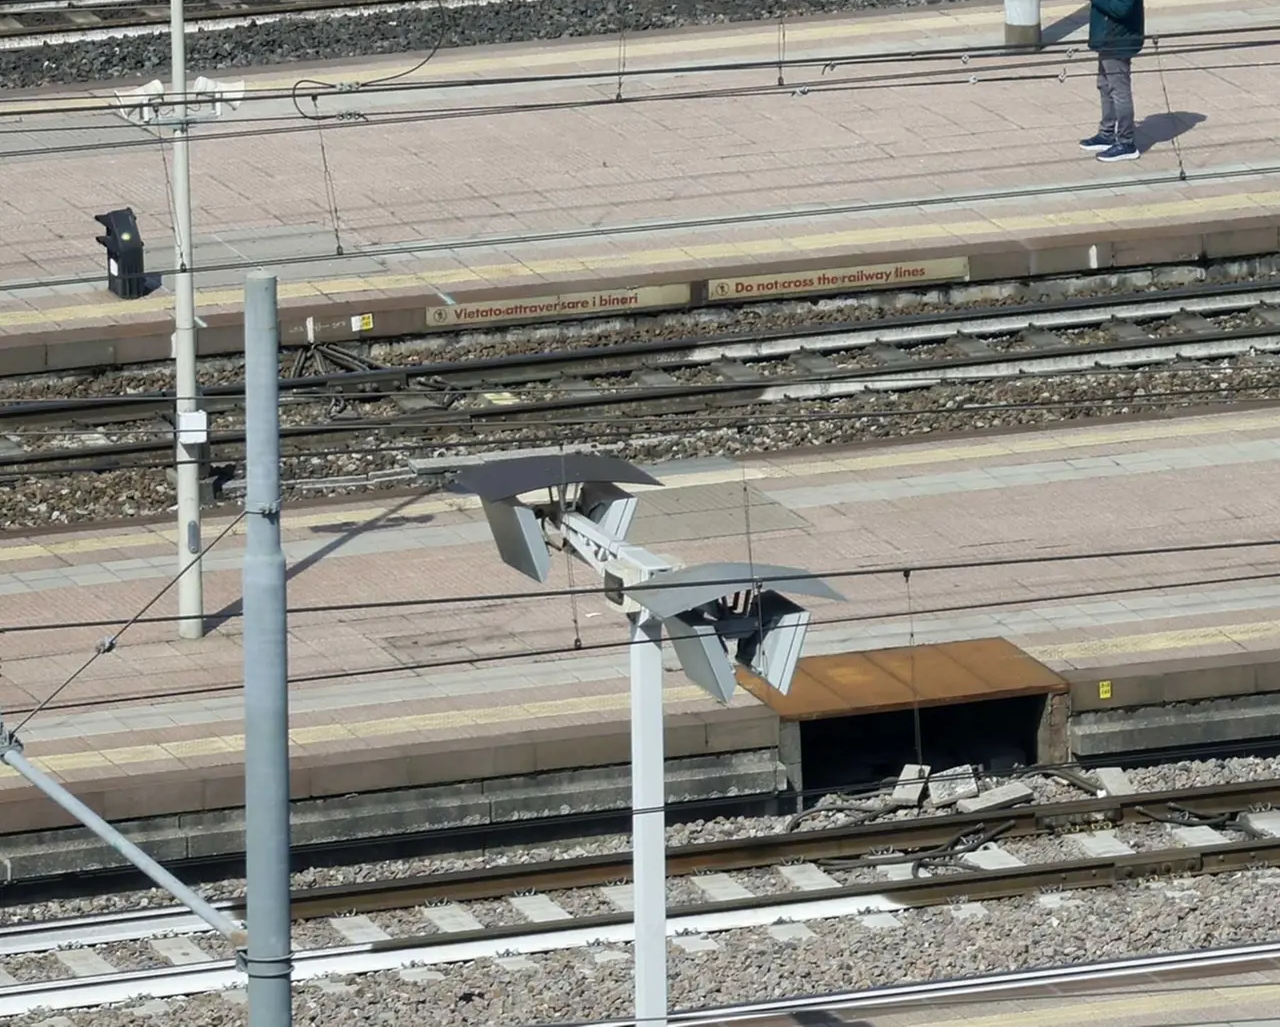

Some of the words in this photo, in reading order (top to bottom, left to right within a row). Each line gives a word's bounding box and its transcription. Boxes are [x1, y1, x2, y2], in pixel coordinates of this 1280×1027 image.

[735, 281, 754, 293] Do
[757, 279, 779, 291] not
[782, 277, 814, 289] cross
[817, 272, 838, 285] the
[841, 267, 892, 287] railway
[894, 265, 926, 279] lines
[454, 306, 502, 321] Vietato
[504, 299, 589, 316] attraversare
[592, 296, 597, 308] i
[600, 292, 639, 307] binari
